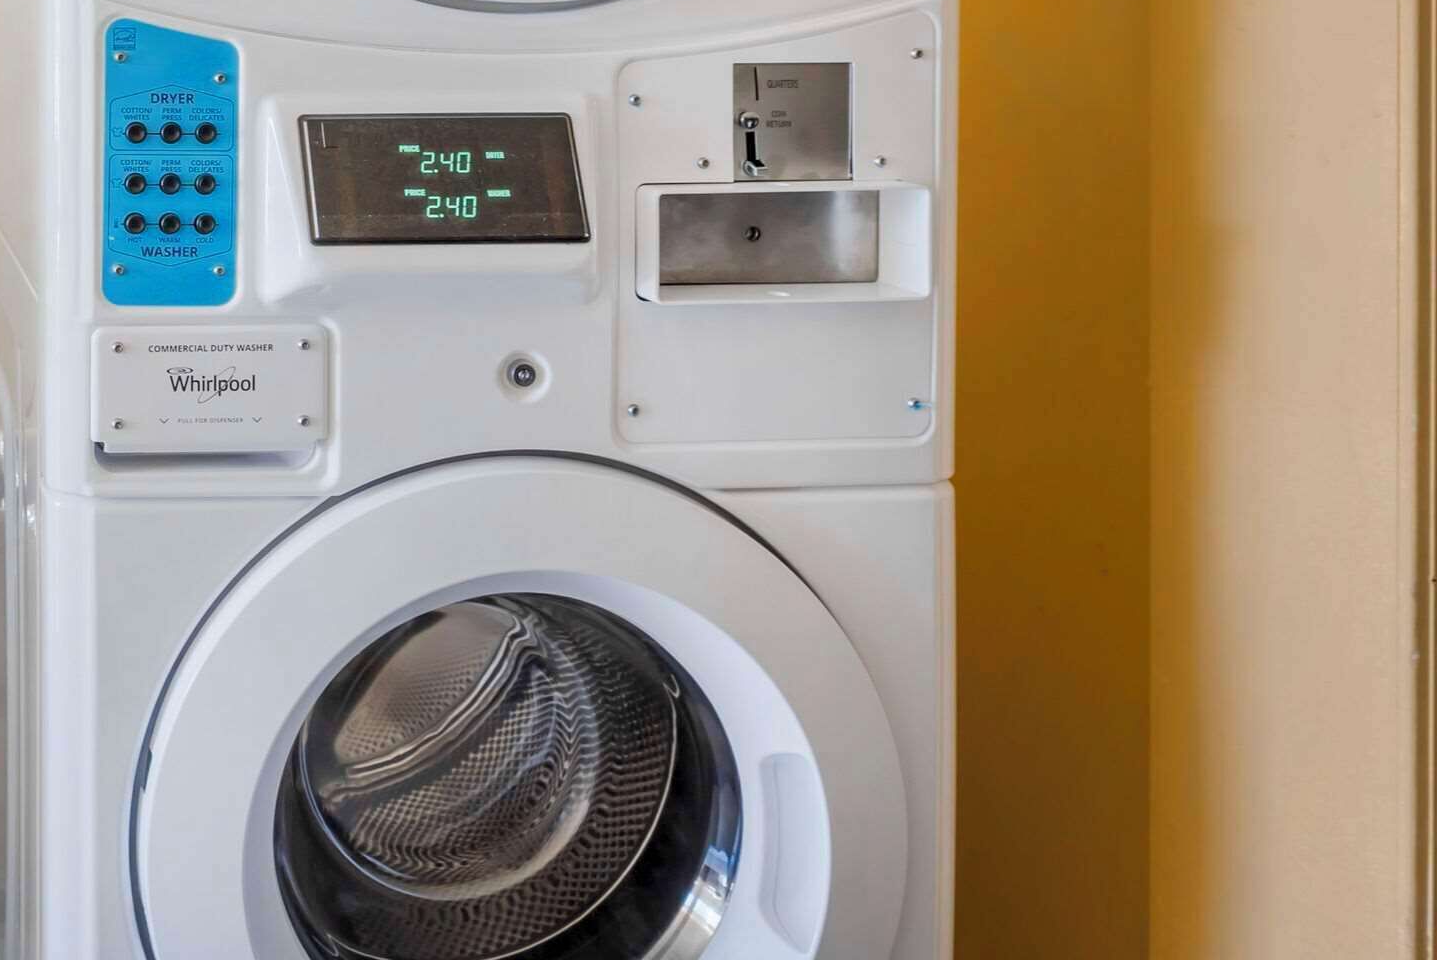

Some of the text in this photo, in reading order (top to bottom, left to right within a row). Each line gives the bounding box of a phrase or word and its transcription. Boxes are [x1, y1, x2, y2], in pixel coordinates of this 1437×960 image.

[150, 93, 195, 104] DRYER
[421, 152, 471, 173] 2.40
[426, 196, 477, 218] 2.40
[141, 246, 199, 257] WASHER
[210, 344, 234, 352] DUTY
[237, 344, 274, 352] WASHER
[169, 374, 256, 397] Whirlpool
